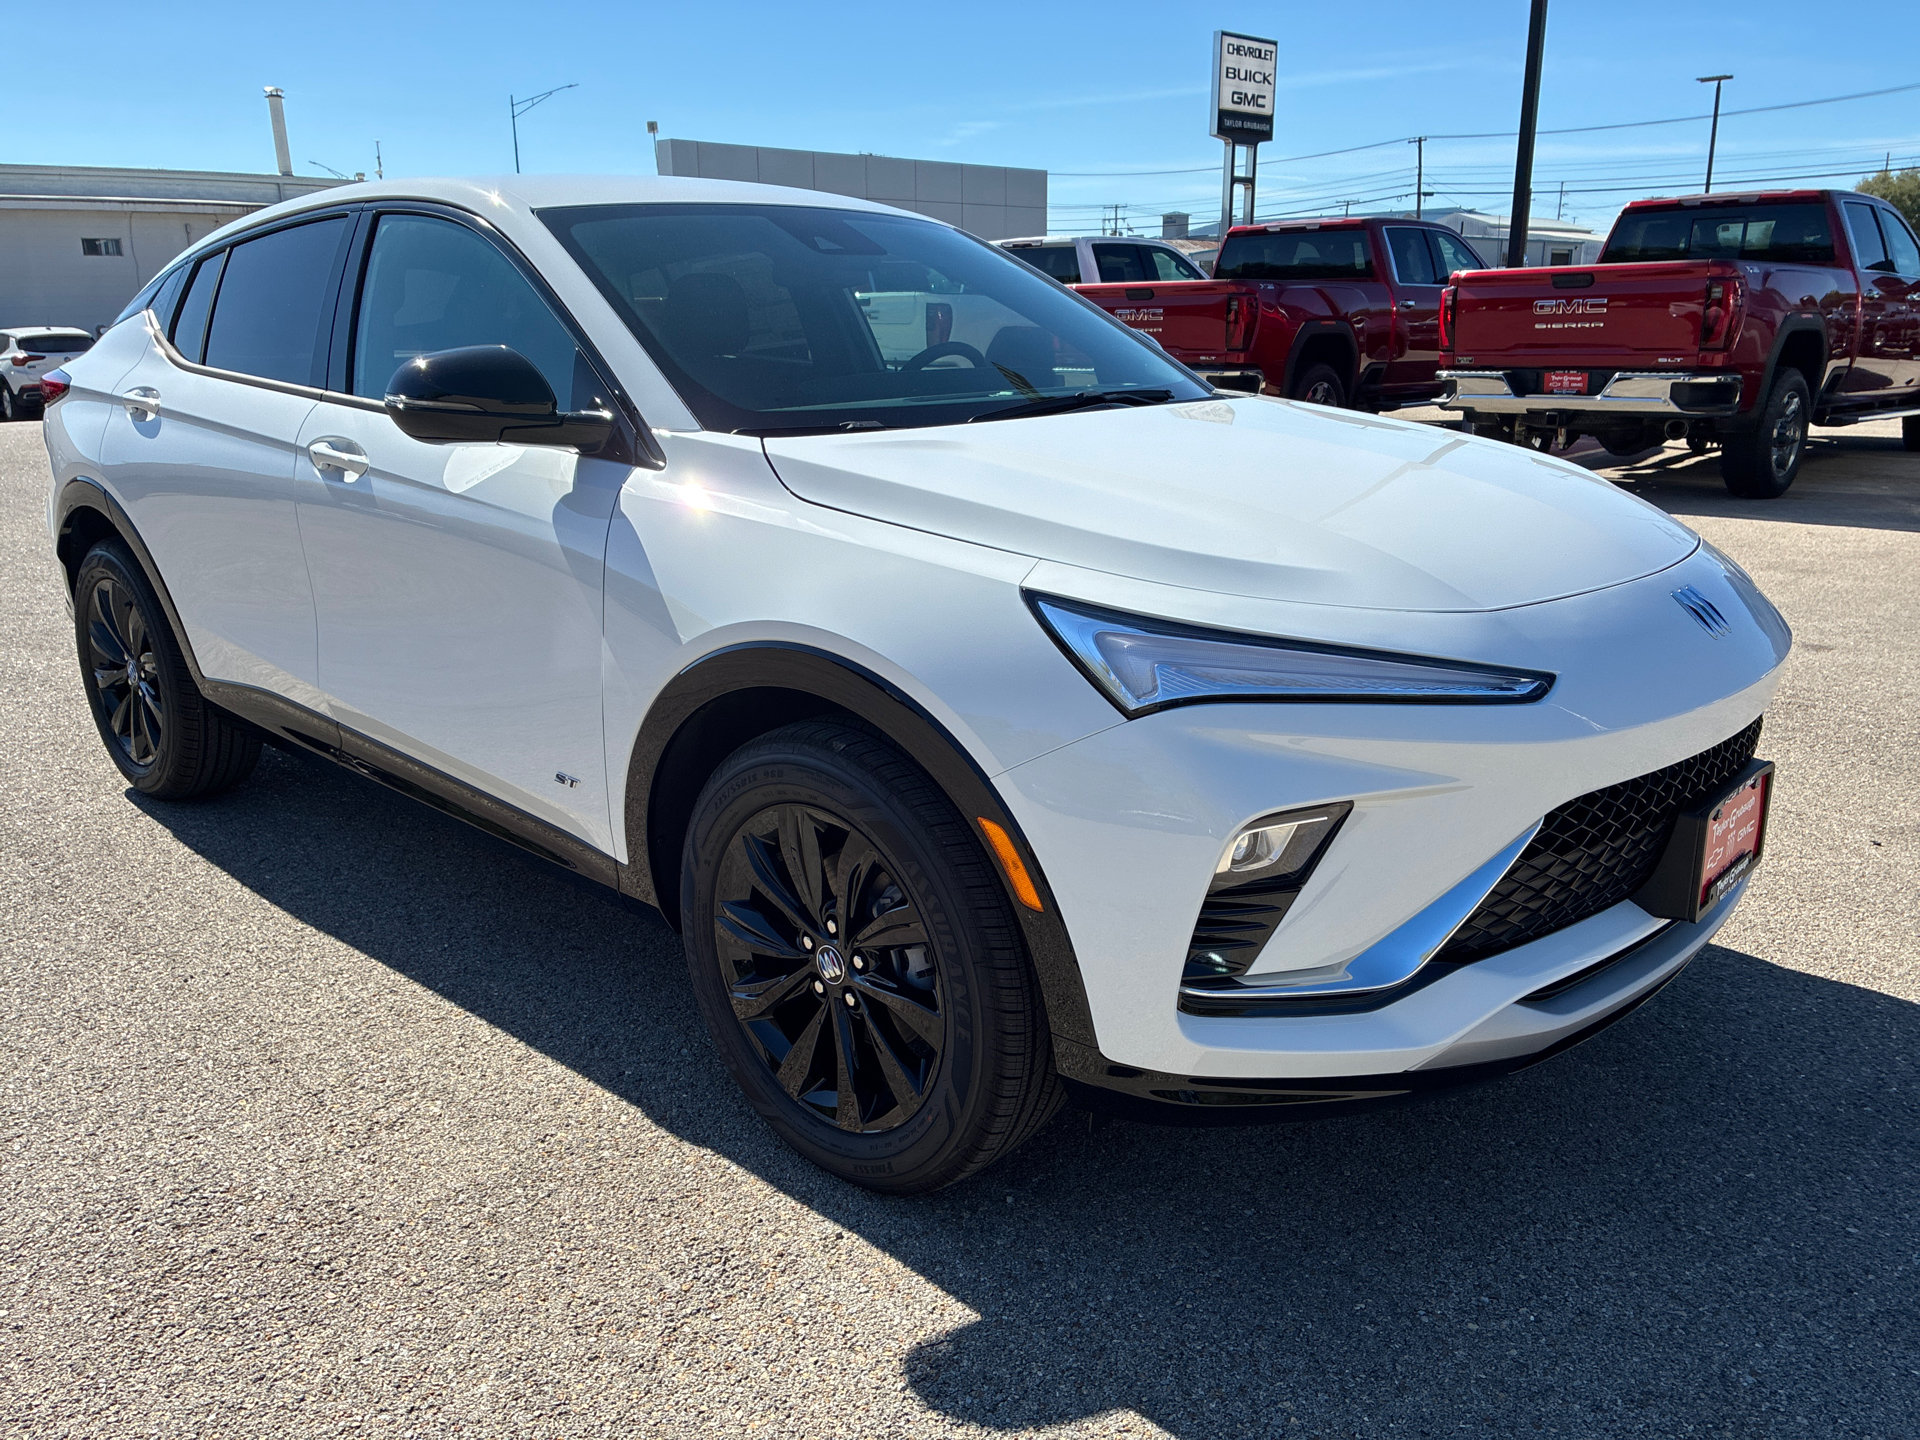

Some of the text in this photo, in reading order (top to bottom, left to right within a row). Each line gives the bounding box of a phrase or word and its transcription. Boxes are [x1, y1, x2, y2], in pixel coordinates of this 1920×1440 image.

[1227, 43, 1273, 61] CHEVROLET
[1225, 67, 1272, 85] BUICK
[1231, 91, 1266, 108] GMC
[1224, 119, 1242, 128] TAYLOR
[1115, 309, 1163, 321] GMC
[1533, 298, 1608, 314] GMC
[554, 771, 582, 789] ST
[1712, 795, 1756, 844] Taylor Grubaugh
[1737, 820, 1755, 842] GMC
